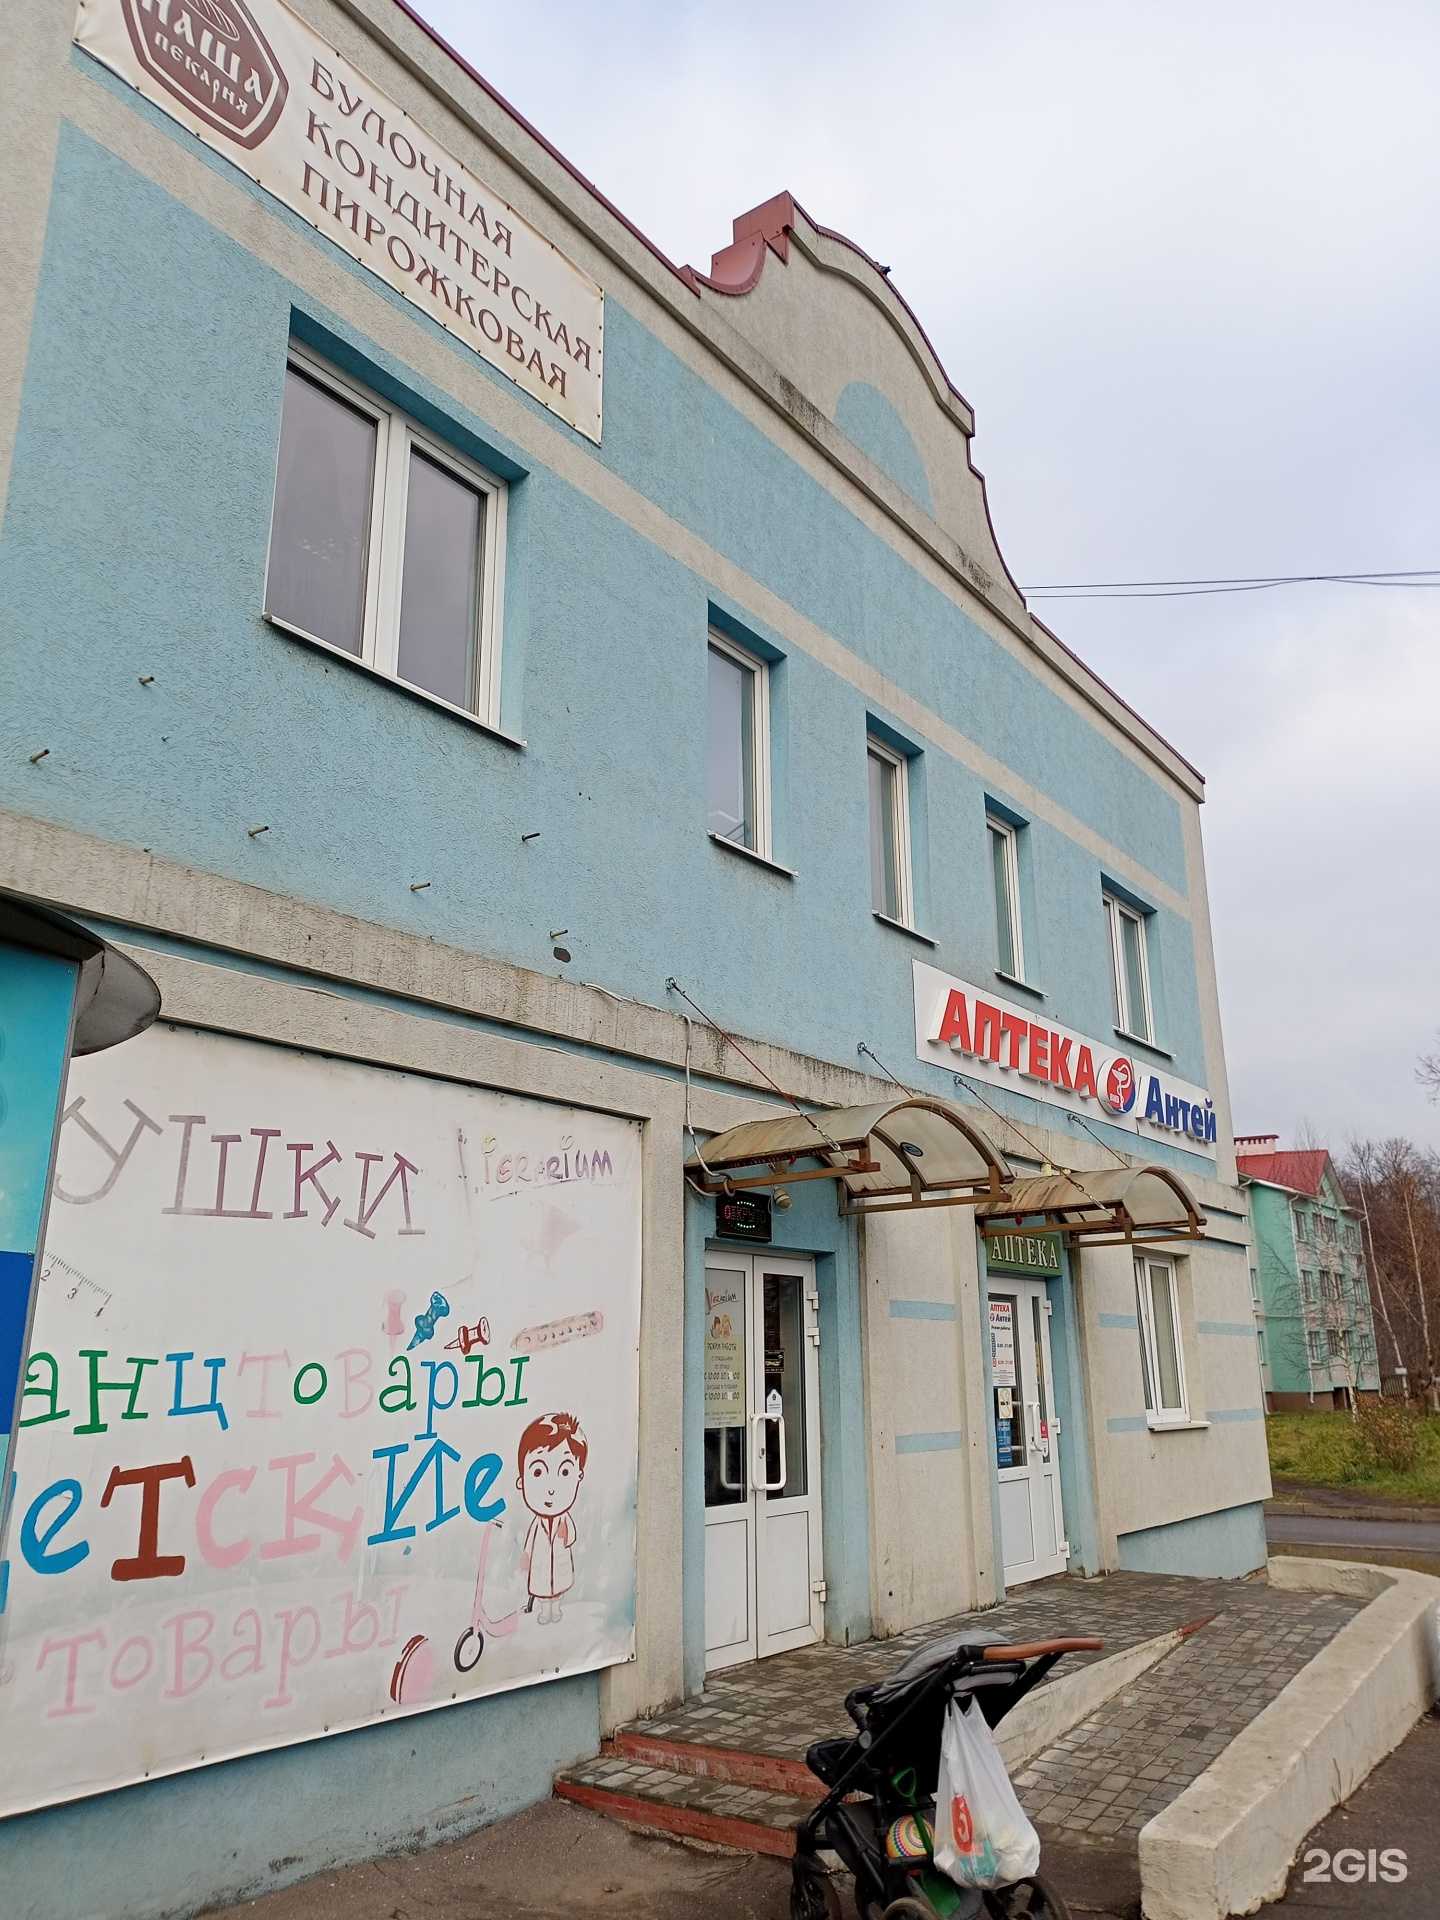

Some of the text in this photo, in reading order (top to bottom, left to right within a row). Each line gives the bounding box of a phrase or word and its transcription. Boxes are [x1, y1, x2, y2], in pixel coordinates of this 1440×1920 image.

[305, 108, 593, 371] КОНДИТЕРСКАЯ
[309, 56, 513, 258] БУЛОЧНАЯ
[300, 161, 568, 399] ПИРОЖКОВАЯ
[936, 988, 1217, 1143] АПТЕКА Антей
[990, 1303, 1010, 1313] АПТЕКА
[991, 1234, 1058, 1269] АПТЕКА
